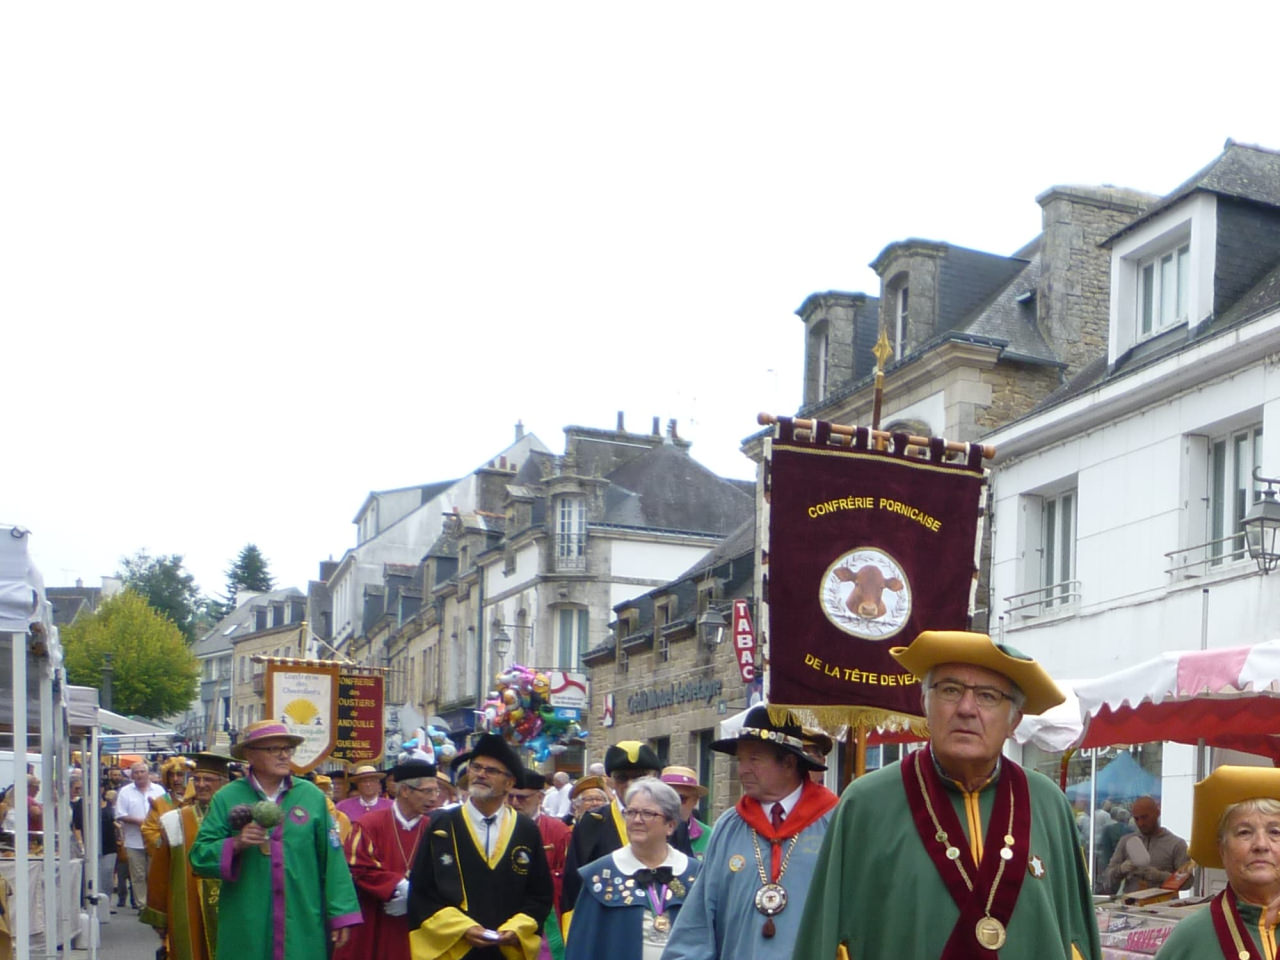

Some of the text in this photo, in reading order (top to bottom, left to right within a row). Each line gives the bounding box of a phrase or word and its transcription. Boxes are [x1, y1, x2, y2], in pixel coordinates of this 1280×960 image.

[807, 496, 942, 532] CONFRÉRIE PORNICAISE
[736, 602, 754, 678] TABAC
[339, 677, 376, 686] ONFRERIE
[804, 653, 921, 686] DE LA TÊTE DE VEA
[338, 698, 376, 708] OUSTIERS
